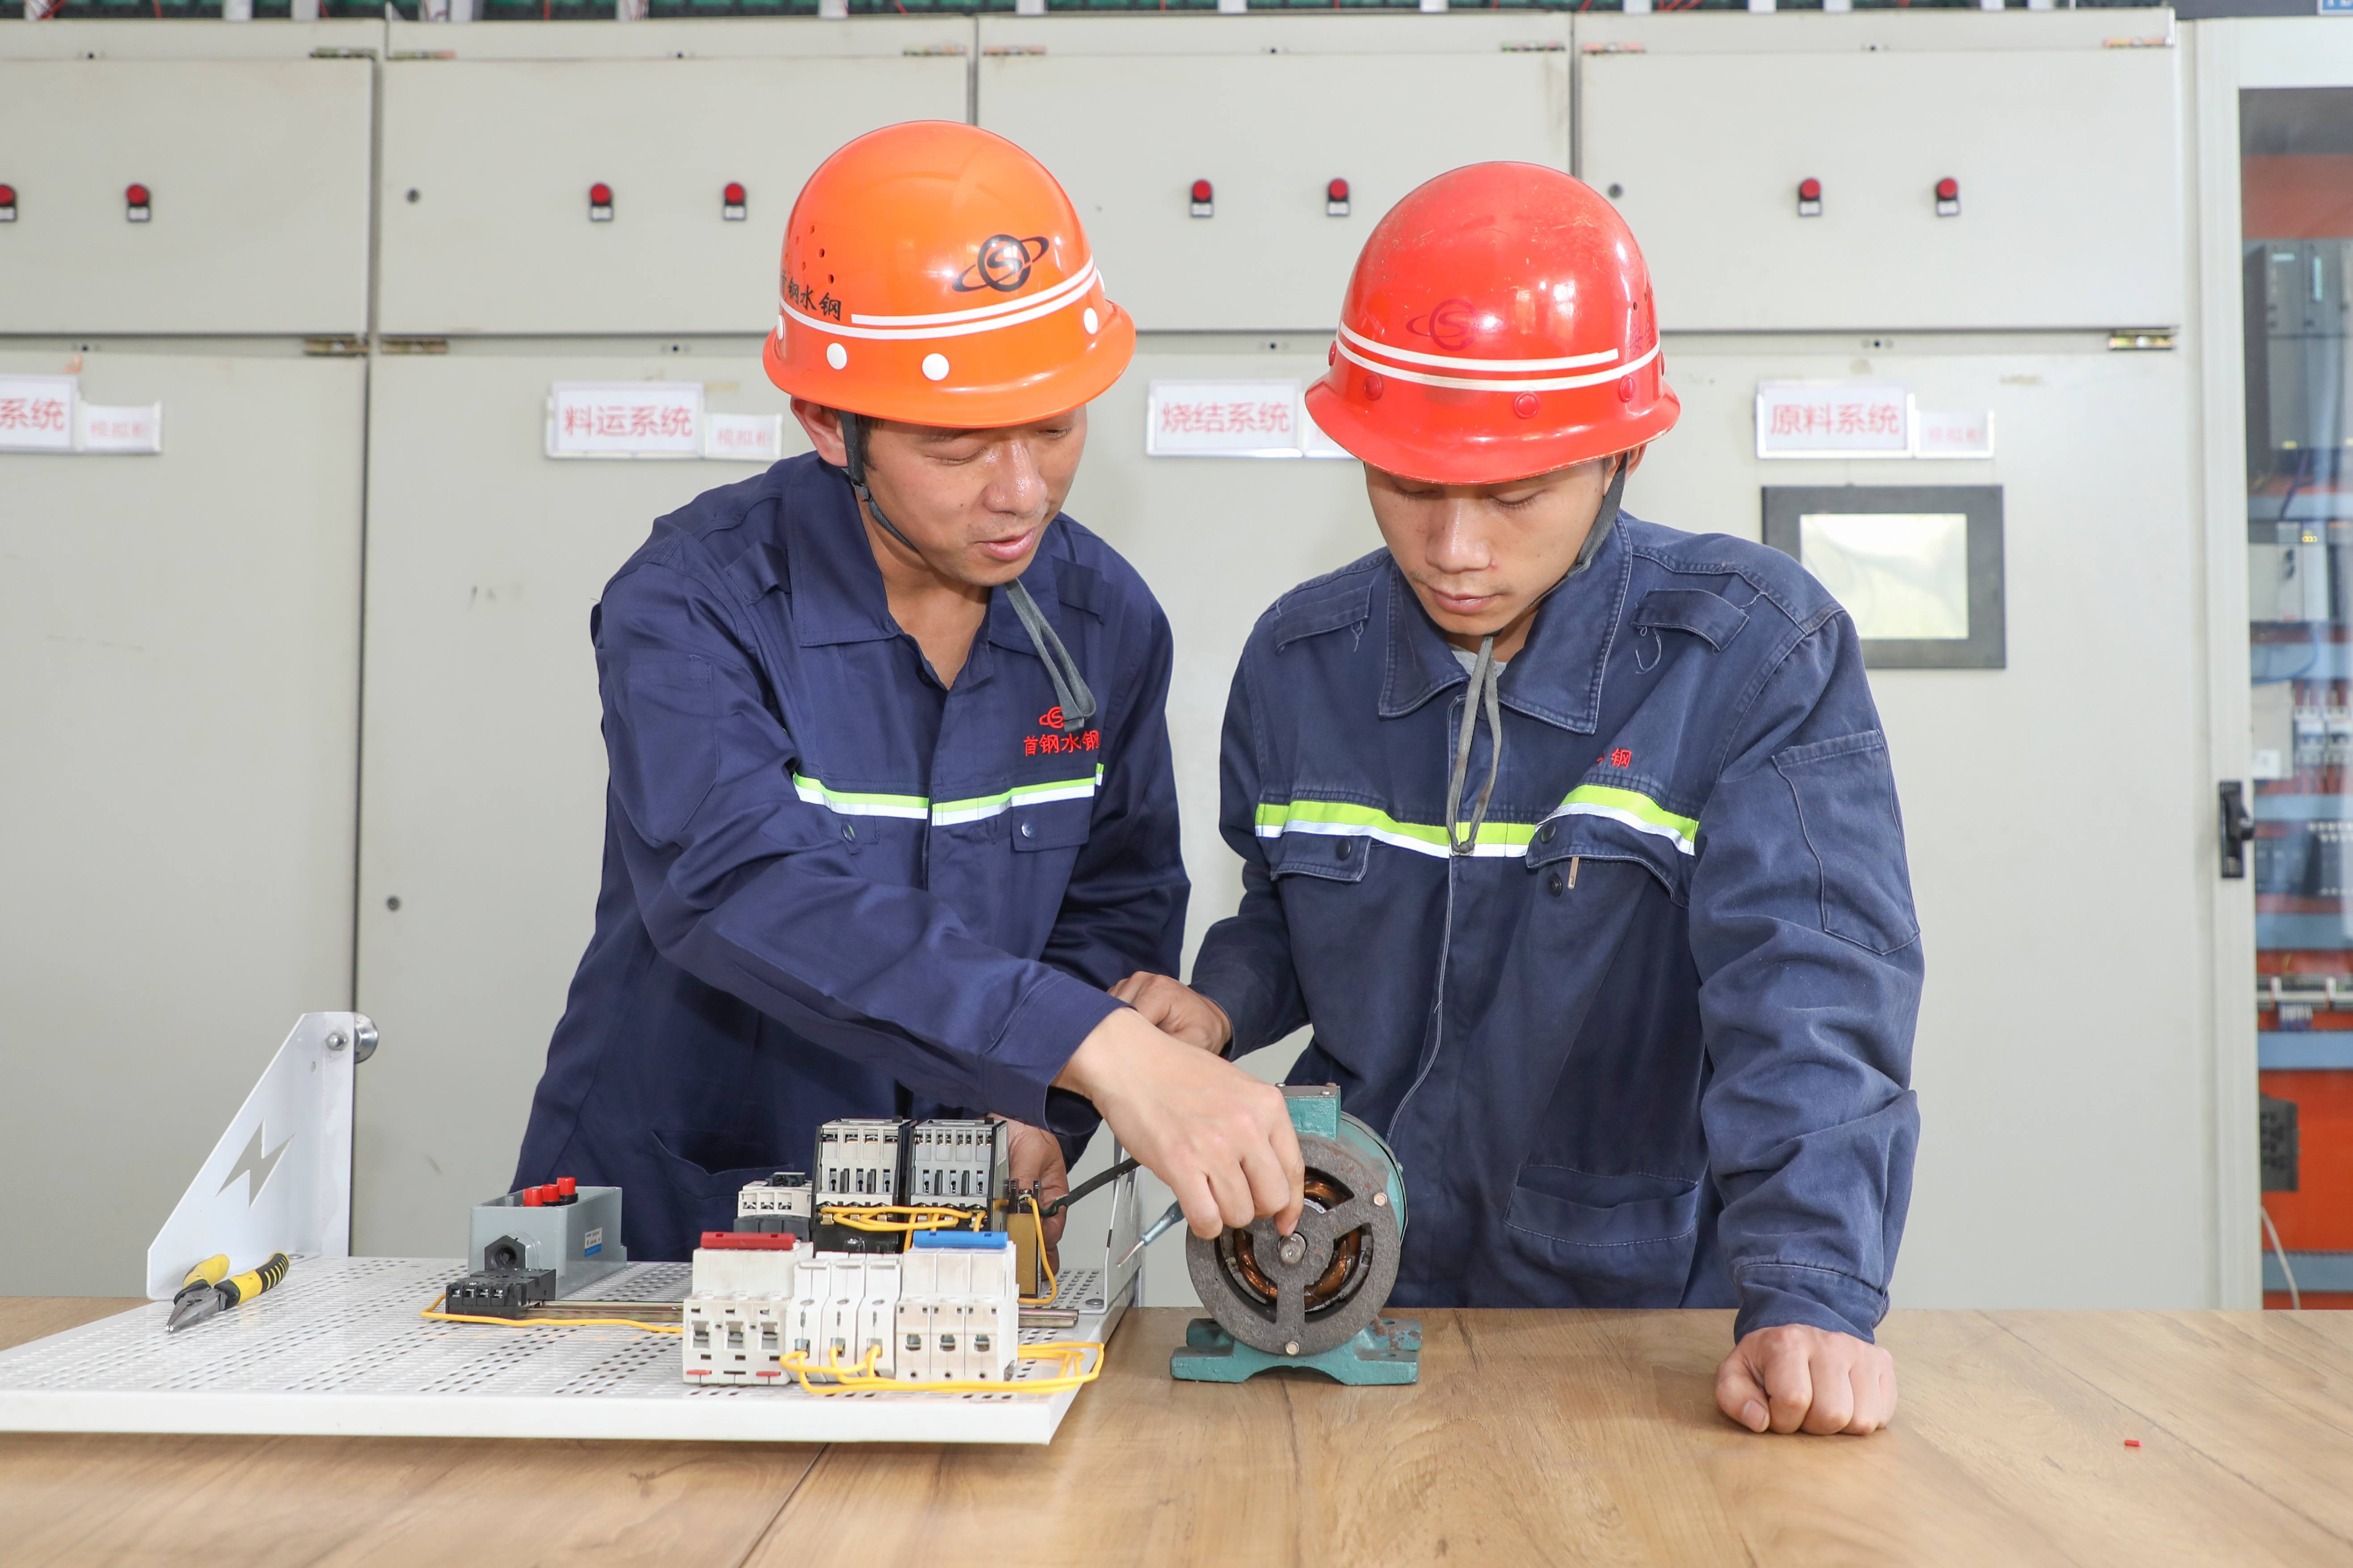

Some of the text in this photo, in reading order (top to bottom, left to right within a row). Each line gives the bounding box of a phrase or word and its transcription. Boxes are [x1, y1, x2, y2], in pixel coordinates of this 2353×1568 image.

[0, 397, 64, 431] 系统
[565, 404, 693, 437] 料运系统
[1161, 400, 1291, 433] 烧结系统
[1770, 402, 1901, 436] 原料系统
[1023, 729, 1100, 756] 首钢水钢
